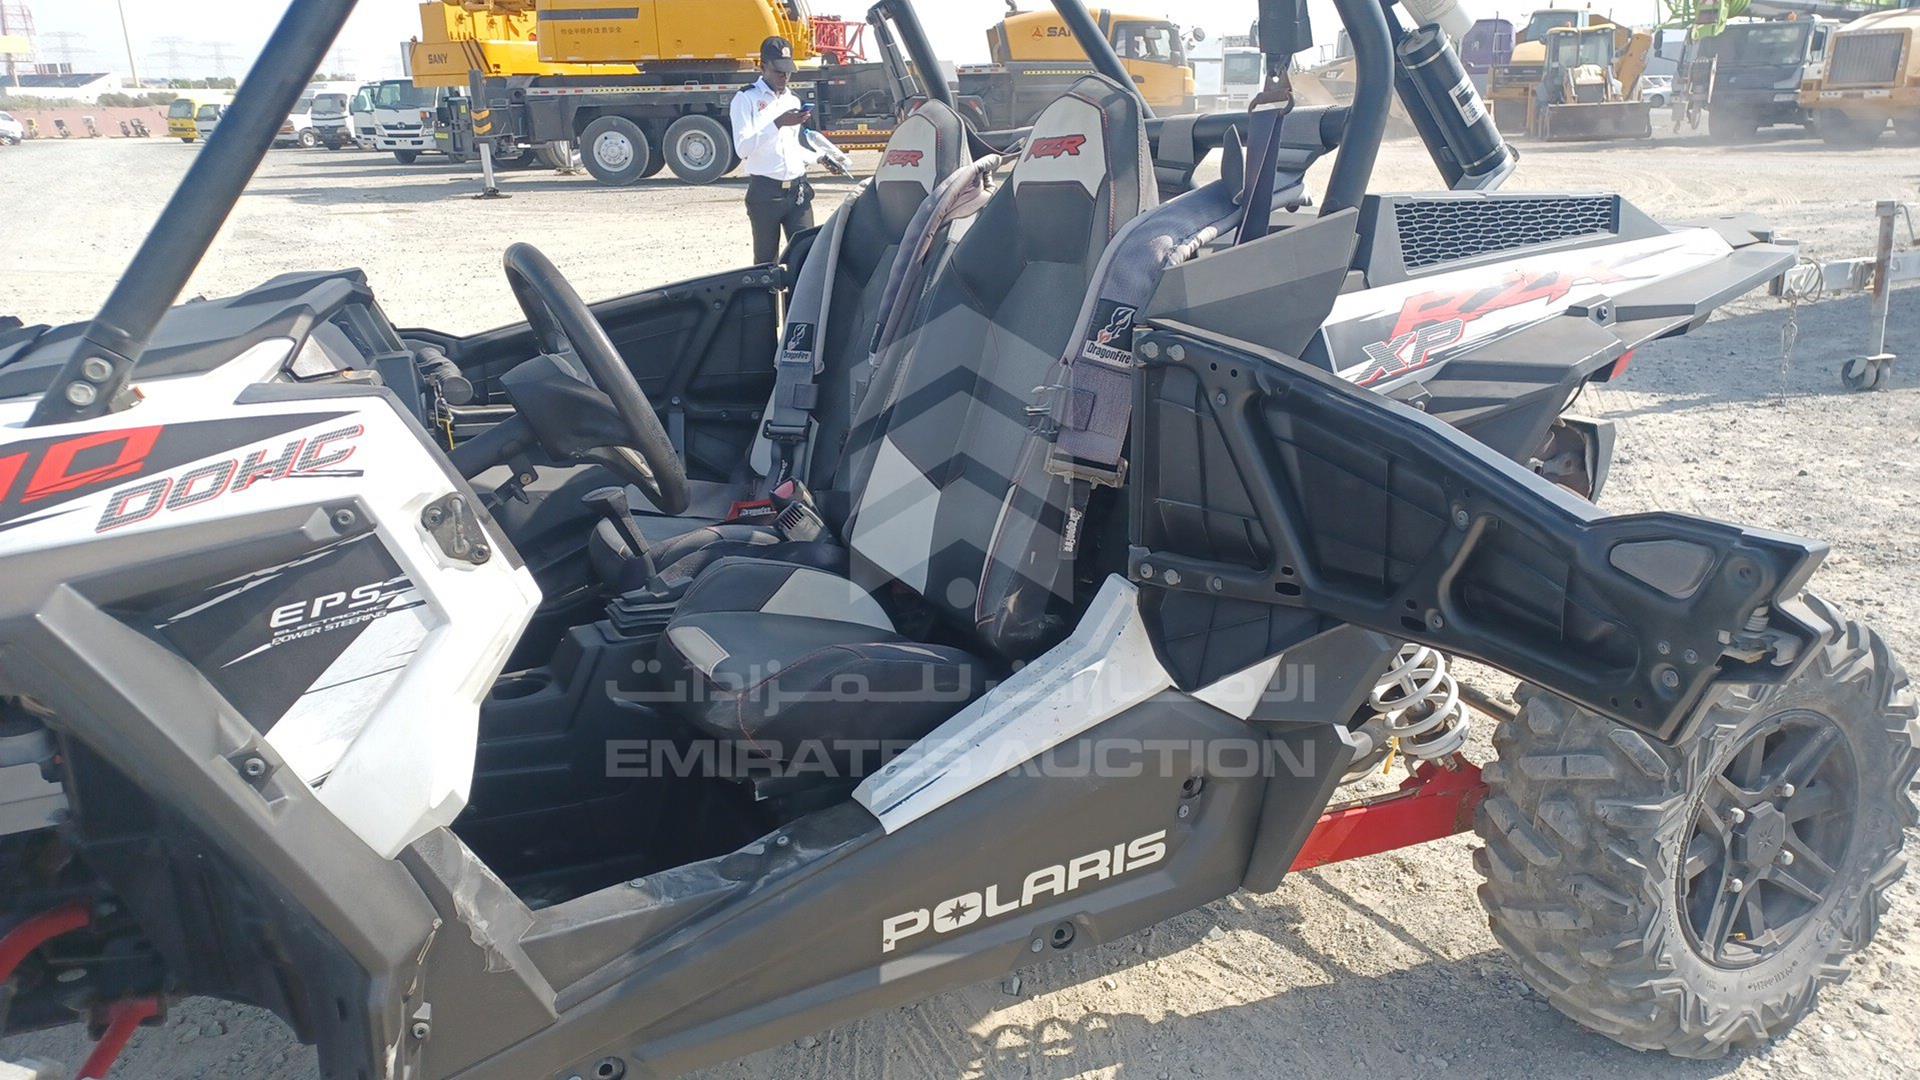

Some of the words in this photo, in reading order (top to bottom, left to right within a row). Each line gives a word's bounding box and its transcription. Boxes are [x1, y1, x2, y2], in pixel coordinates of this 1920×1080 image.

[428, 53, 448, 64] SANY
[1023, 134, 1086, 162] RZR
[1087, 342, 1131, 364] DragonFire
[1353, 318, 1466, 387] XP
[0, 424, 164, 504] 0
[95, 424, 364, 533] DOHC
[270, 581, 385, 628] EPS
[274, 603, 385, 637] ELECTRONIC
[271, 627, 322, 646] POWER
[324, 609, 388, 632] STEERING
[883, 829, 1166, 953] POLARIS
